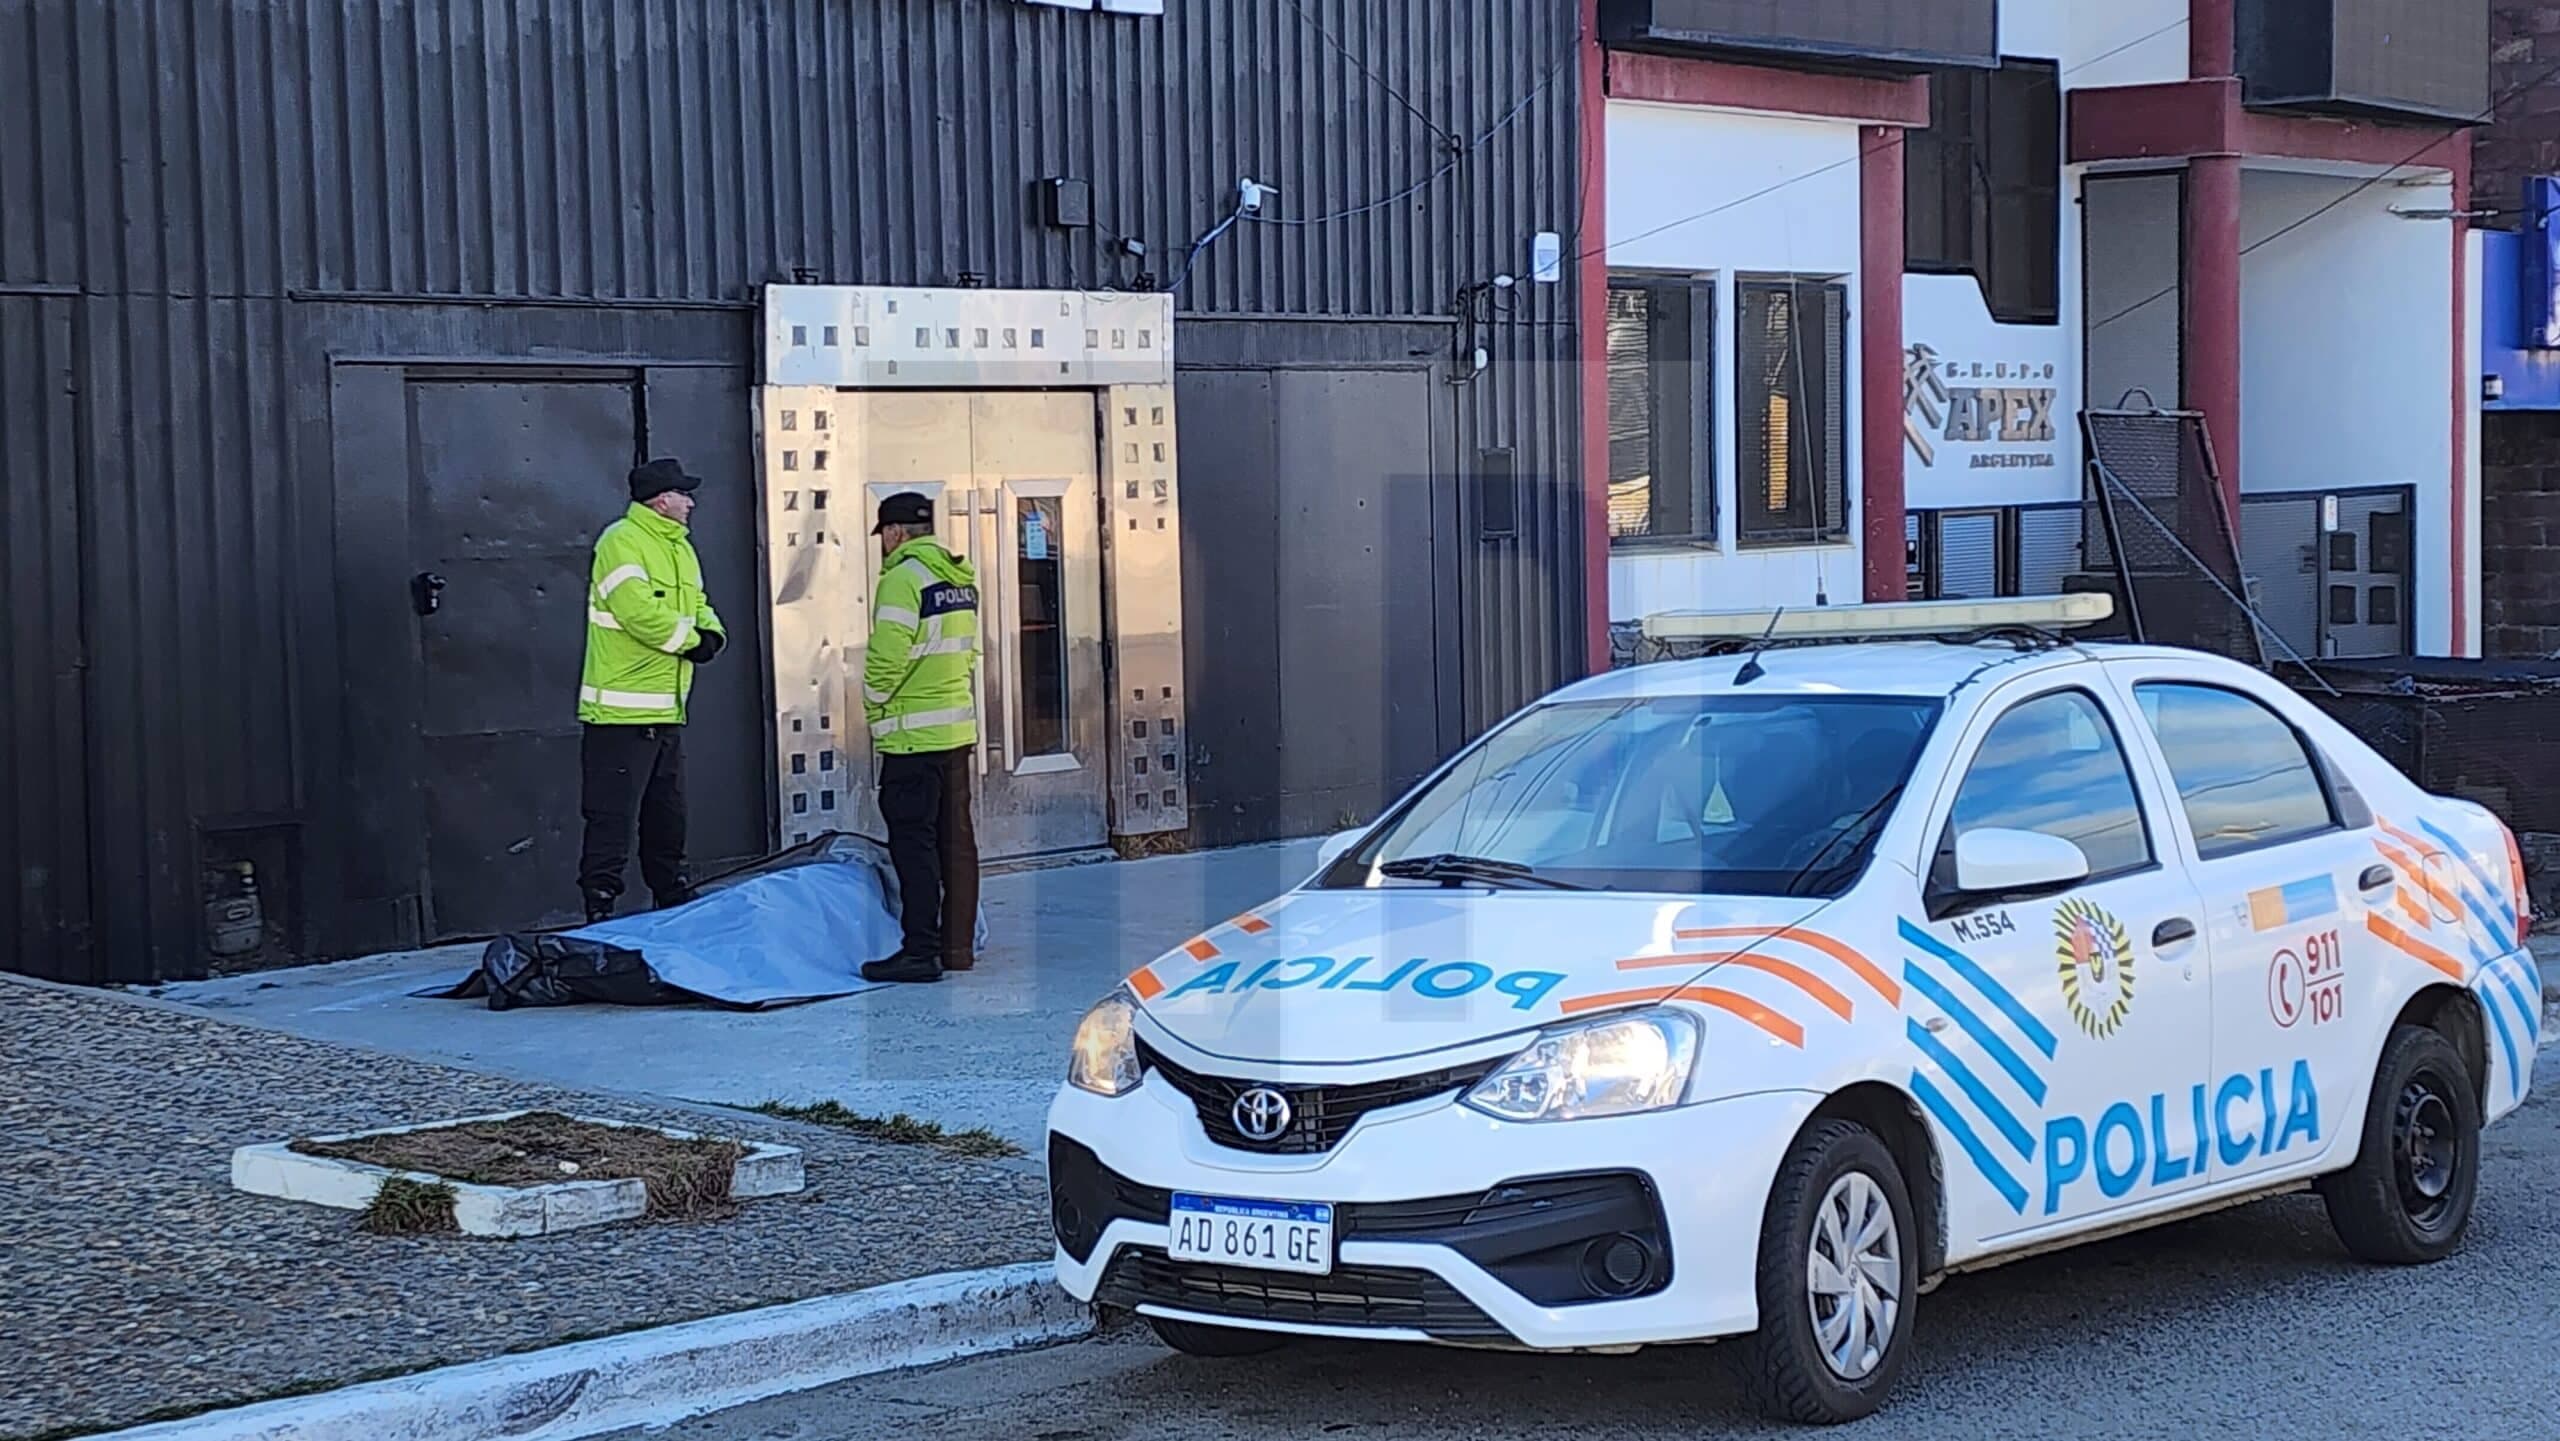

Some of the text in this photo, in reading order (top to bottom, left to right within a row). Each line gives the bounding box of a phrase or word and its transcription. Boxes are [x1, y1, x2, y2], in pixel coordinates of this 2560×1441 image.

[1943, 388, 2056, 441] APEX
[1951, 910, 2016, 943] M.554
[2306, 929, 2341, 975] 911
[2310, 984, 2342, 1025] 101
[2044, 1059, 2320, 1216] POLICIA
[1178, 1217, 1321, 1264] AD 861 GE
